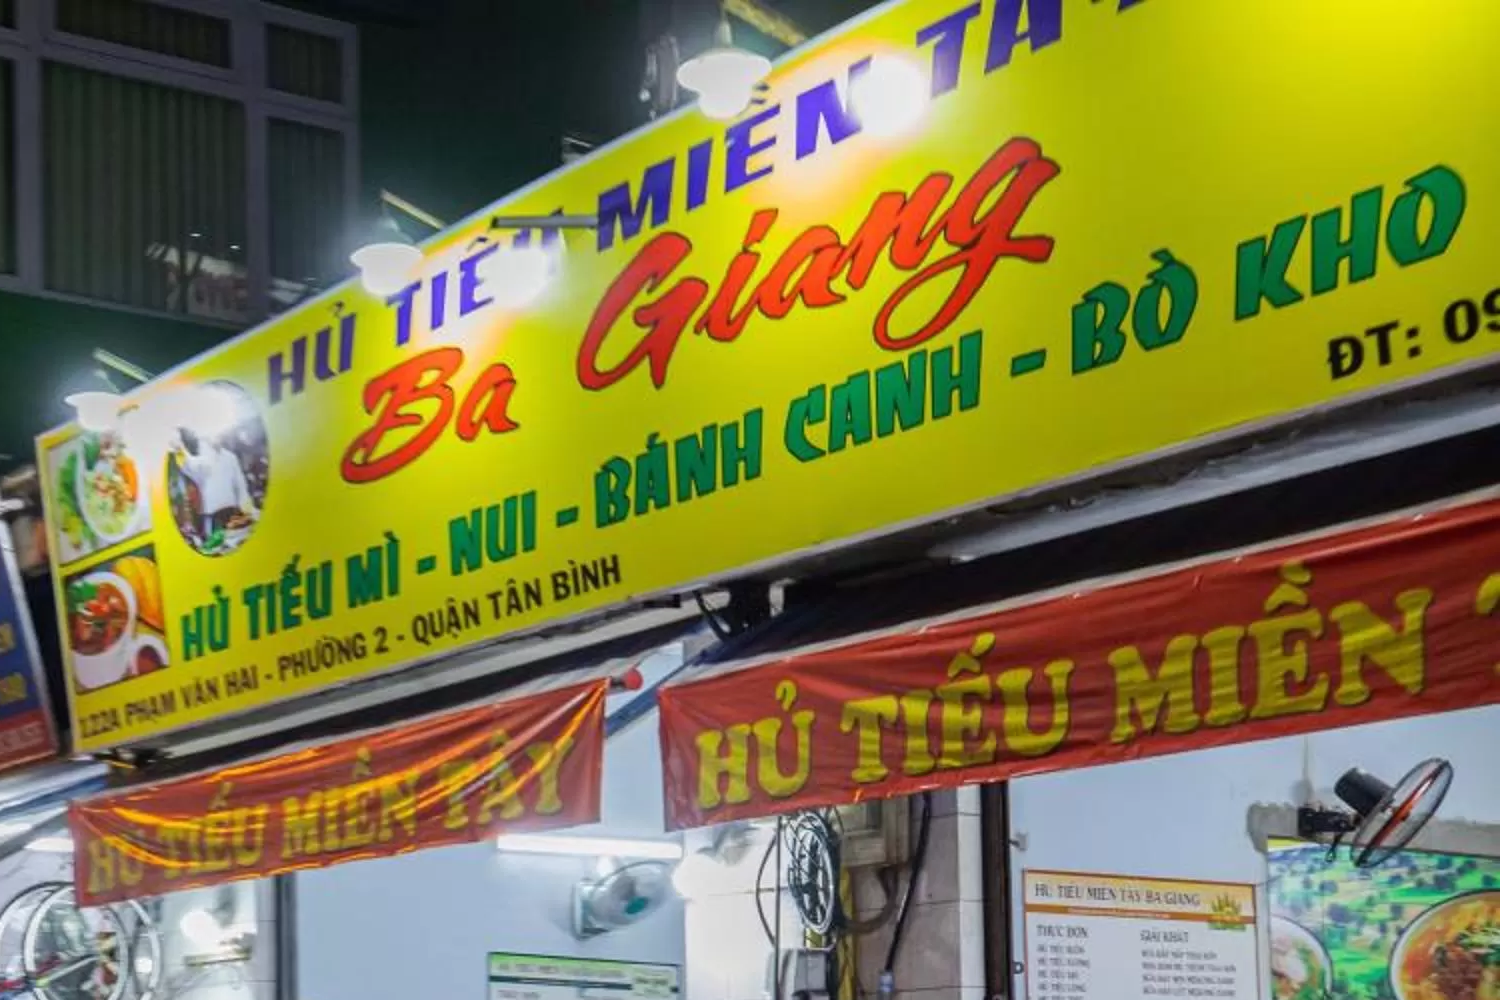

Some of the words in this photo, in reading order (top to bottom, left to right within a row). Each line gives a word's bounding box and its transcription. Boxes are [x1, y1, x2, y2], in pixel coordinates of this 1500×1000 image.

[268, 301, 356, 405] HỦ
[340, 347, 520, 484] Ba
[576, 136, 1061, 389] Giang
[1328, 319, 1422, 381] ĐT:
[180, 585, 230, 662] HỦ
[242, 554, 333, 640] TIẾU
[345, 530, 401, 609] MÌ
[448, 490, 536, 576] NUI
[594, 408, 764, 529] BÁNH
[784, 330, 983, 463] CANH
[1071, 248, 1199, 375] BÒ
[1234, 164, 1467, 321] KHO
[224, 664, 260, 698] HAI
[277, 632, 367, 682] PHƯỜNG
[373, 626, 389, 654] 2
[412, 598, 481, 646] QUẬN
[487, 578, 543, 621] TÂN
[552, 554, 622, 602] BÌNH
[695, 680, 815, 810] HỦ
[840, 631, 1074, 783] TIẾU
[1107, 560, 1433, 744] MIỀN
